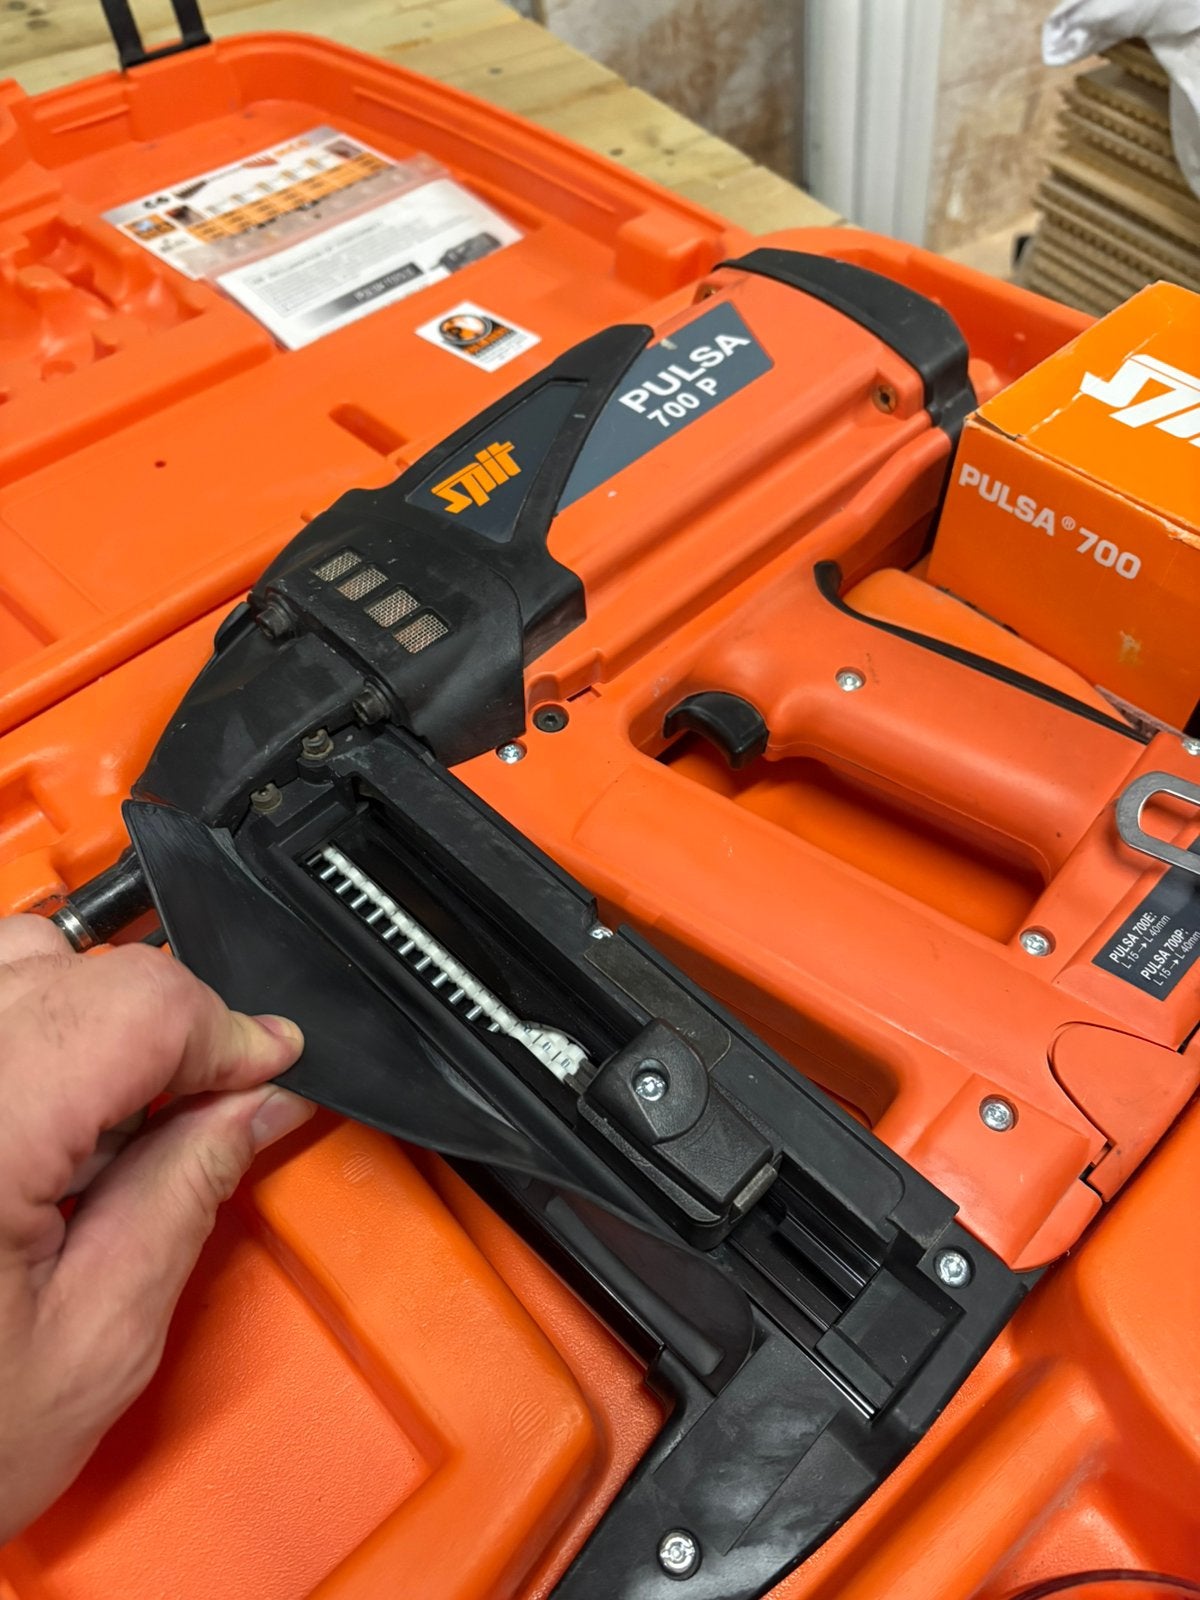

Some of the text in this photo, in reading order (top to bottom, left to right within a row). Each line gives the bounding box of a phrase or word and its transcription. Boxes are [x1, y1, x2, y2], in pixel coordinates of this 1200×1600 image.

[619, 332, 751, 414] PULSA
[647, 377, 721, 429] 700 P
[1076, 528, 1142, 580] 700
[1109, 912, 1157, 963] PULSA 700E:
[1121, 961, 1131, 969] L
[1127, 950, 1139, 963] 15
[1149, 915, 1171, 936] 40mm
[1140, 928, 1189, 980] PULSA 700P:
[1153, 978, 1163, 986] L
[1158, 966, 1171, 980] 15
[1175, 952, 1185, 960] L
